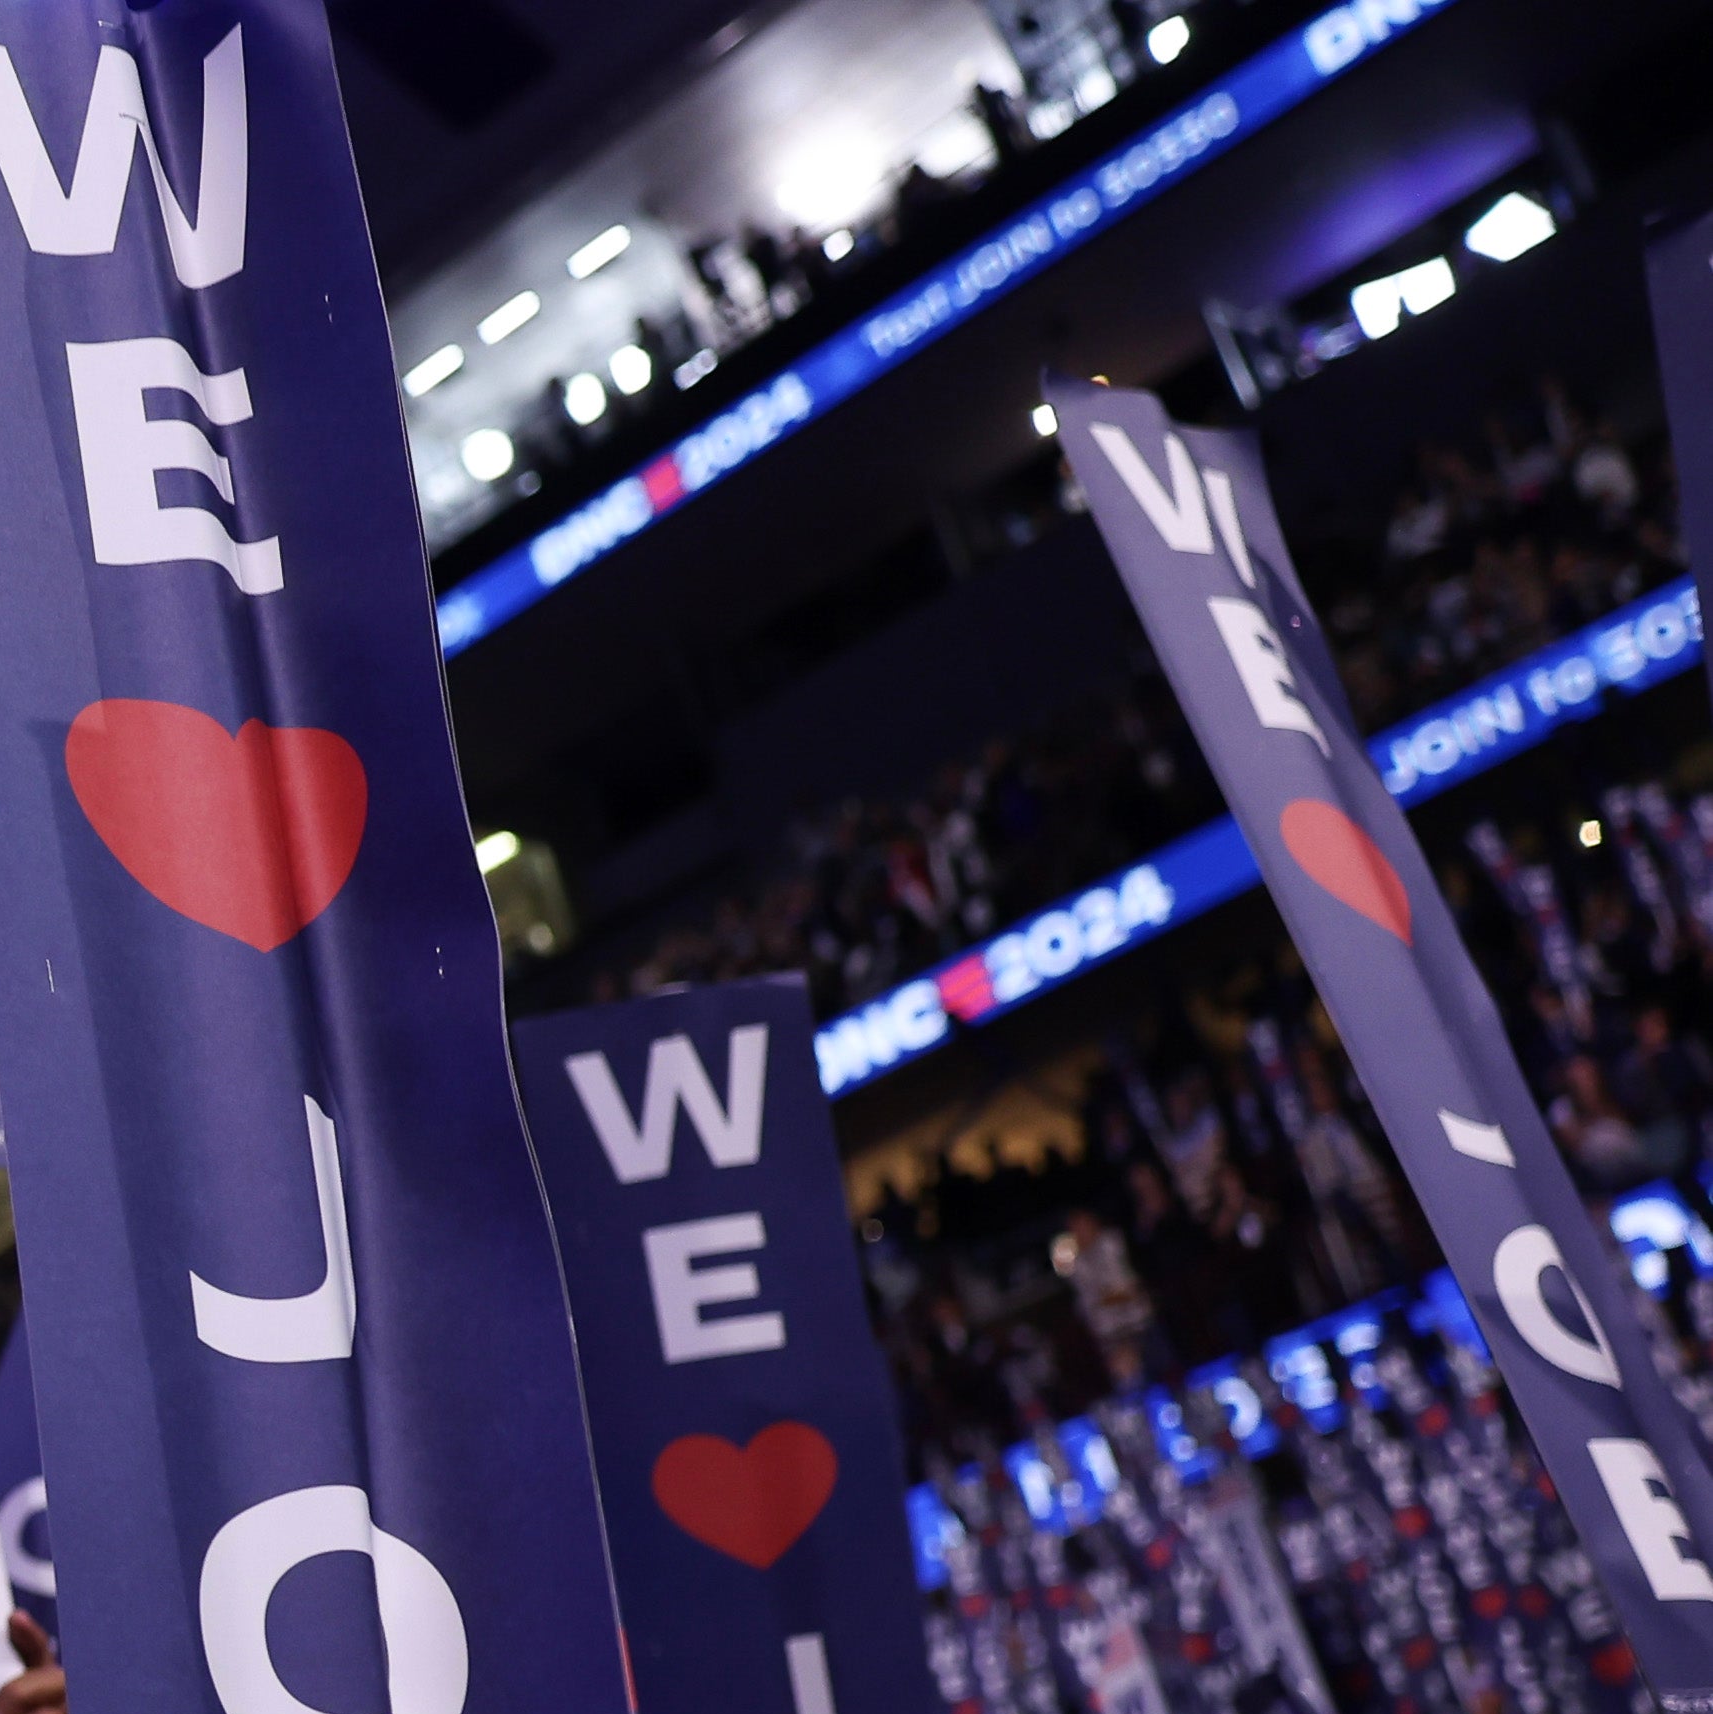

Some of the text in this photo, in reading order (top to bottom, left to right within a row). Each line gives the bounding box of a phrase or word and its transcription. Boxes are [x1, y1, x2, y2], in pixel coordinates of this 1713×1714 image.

[1381, 682, 1526, 796] JOIN
[981, 862, 1176, 1004] 2024
[564, 1022, 786, 1366] WE
